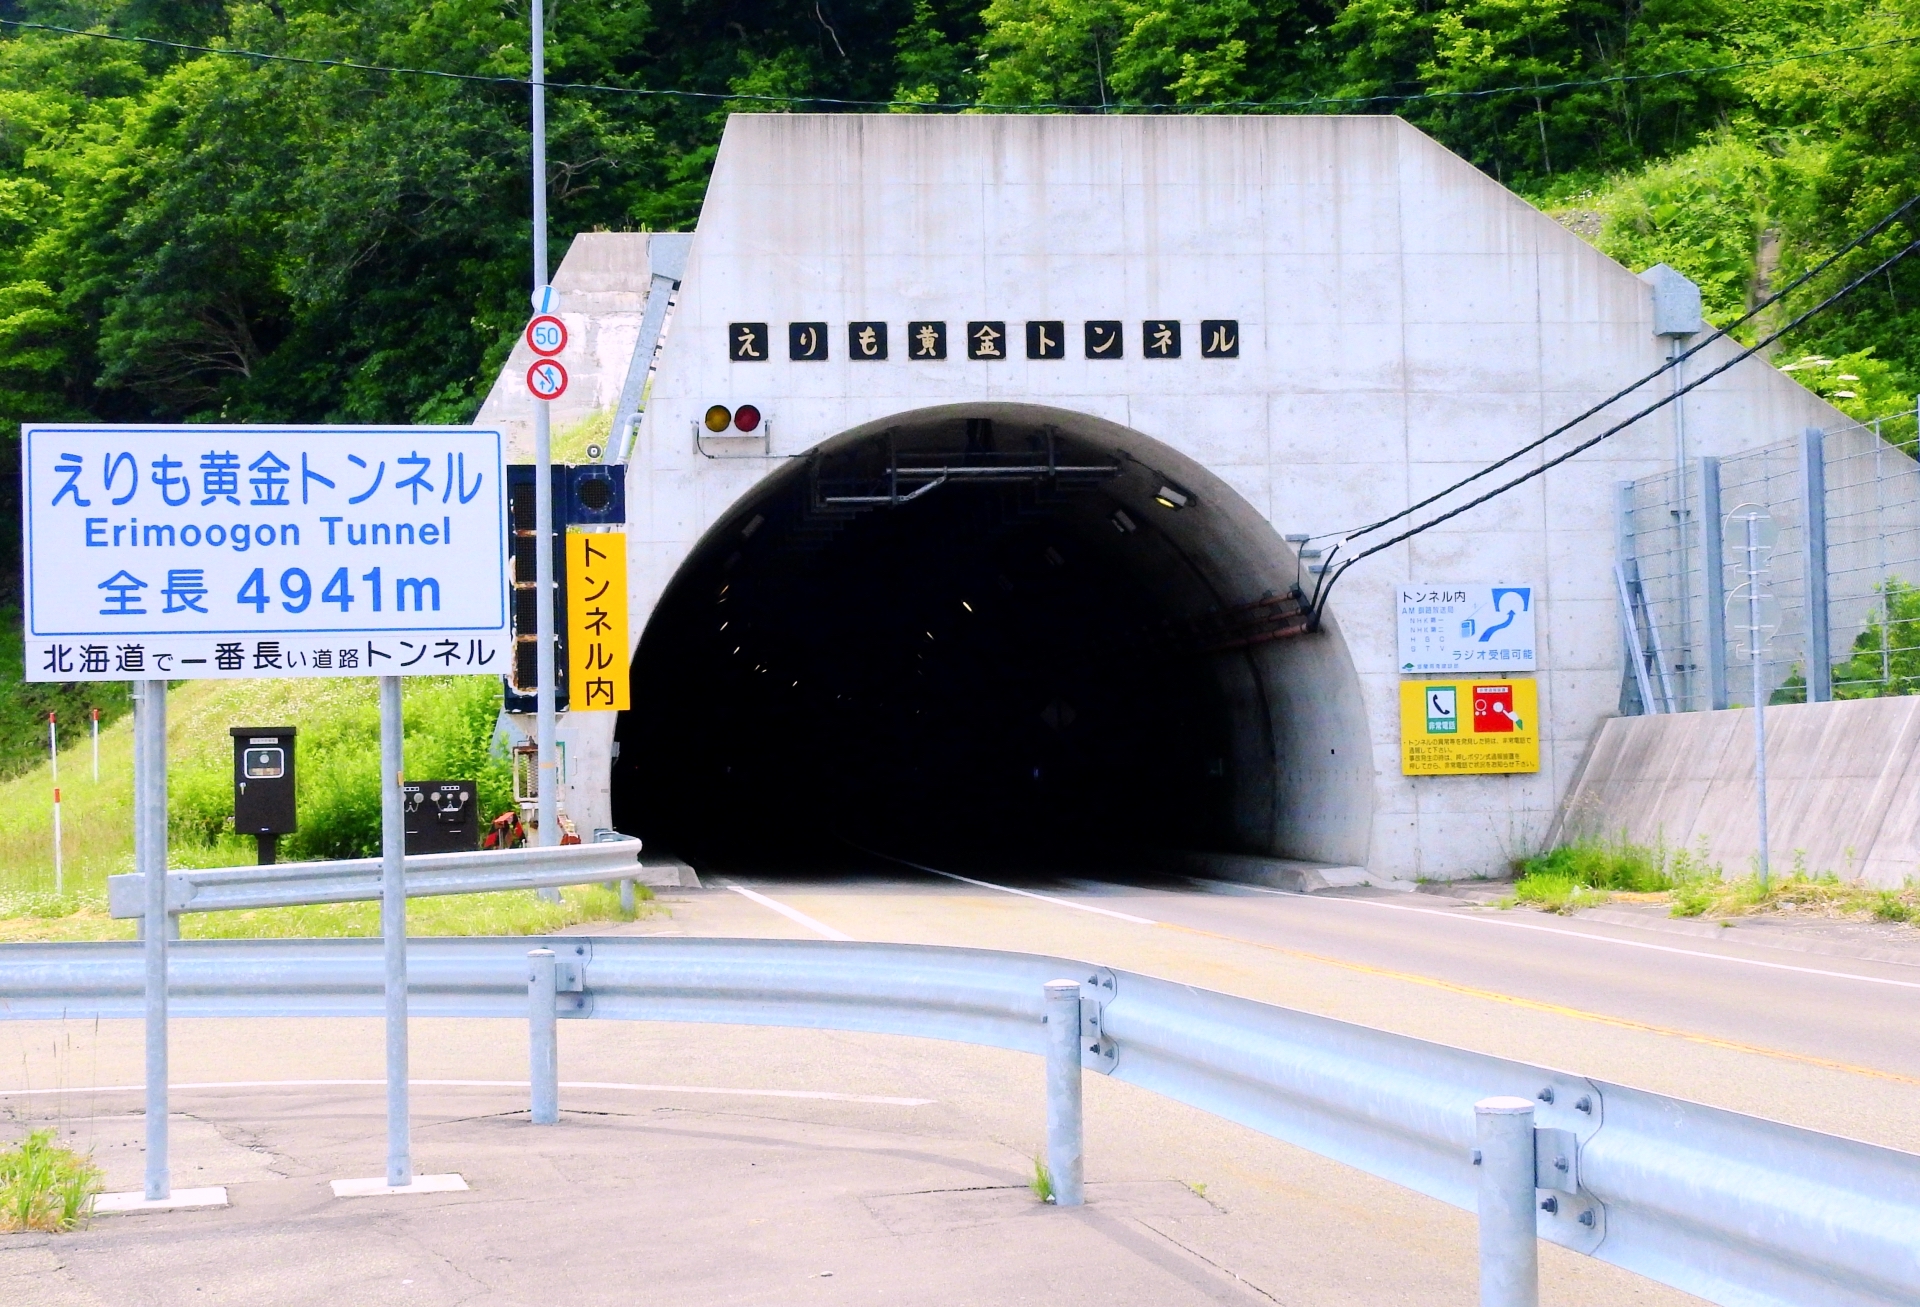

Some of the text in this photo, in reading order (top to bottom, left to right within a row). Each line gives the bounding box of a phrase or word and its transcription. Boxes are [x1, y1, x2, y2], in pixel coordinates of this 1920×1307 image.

[535, 327, 559, 345] 50
[737, 324, 1236, 359] えりも黄金トンネル
[51, 450, 483, 507] えりも黄金トンネル
[85, 515, 452, 552] Erimoogon Tunnel
[97, 566, 441, 615] 全長 4941m
[1403, 590, 1466, 604] トンネル内
[583, 538, 615, 707] トンネル内
[43, 638, 496, 674] 北海道で一番長い道路トンネル
[1452, 649, 1533, 661] ラジオ受信可能
[1428, 720, 1456, 731] 非常電話
